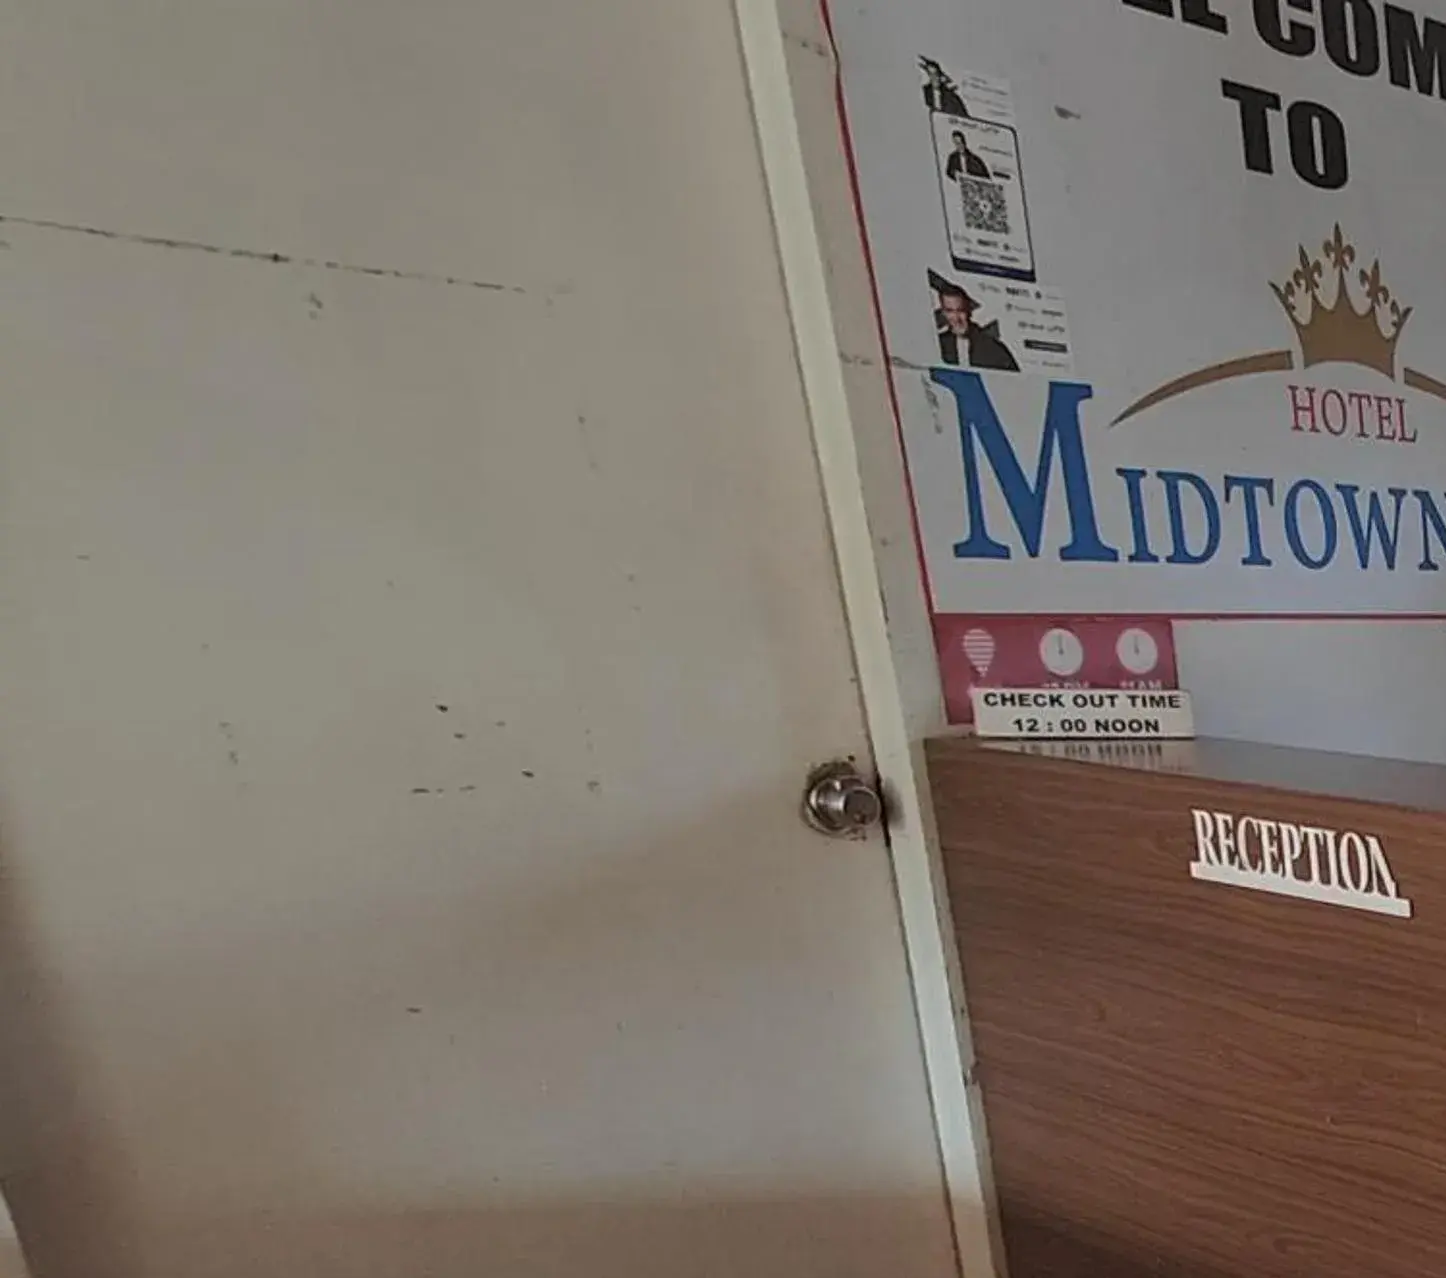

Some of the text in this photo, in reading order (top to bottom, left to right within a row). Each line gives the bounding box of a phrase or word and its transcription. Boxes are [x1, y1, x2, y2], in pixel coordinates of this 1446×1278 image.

[1221, 78, 1350, 190] TO
[1288, 385, 1418, 444] HOTEL
[983, 692, 1181, 709] CHECK OUT TIME
[1012, 719, 1039, 732] 12
[1095, 719, 1160, 733] NOON
[1191, 808, 1397, 900] RECEPTION
